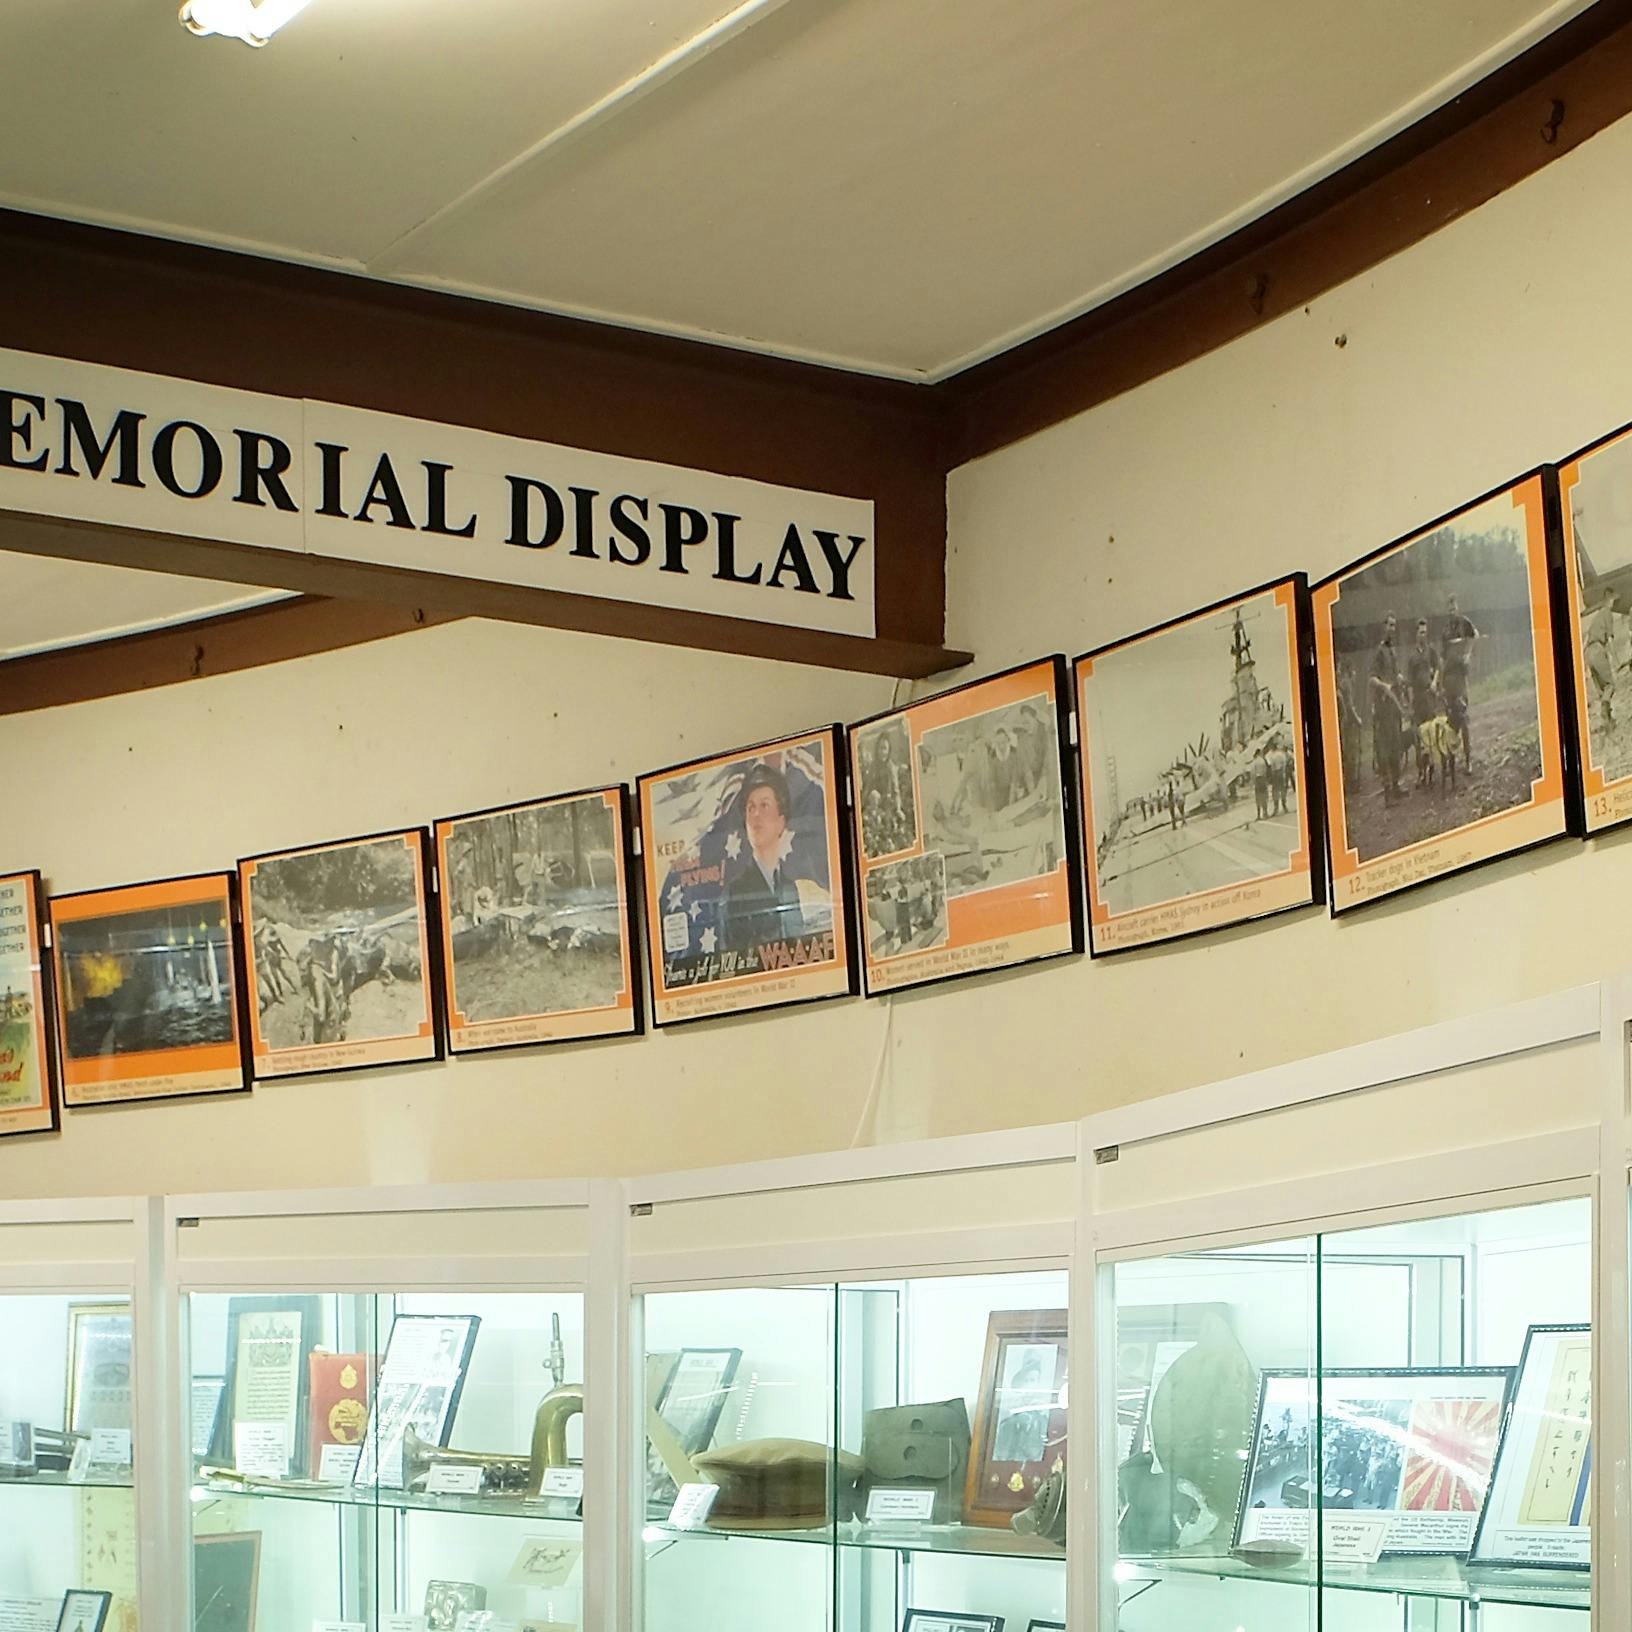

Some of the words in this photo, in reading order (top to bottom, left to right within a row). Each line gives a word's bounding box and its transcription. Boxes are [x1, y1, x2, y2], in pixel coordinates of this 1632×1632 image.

[505, 473, 867, 602] DISPLAY
[1594, 798, 1612, 817] 13.
[657, 840, 685, 857] KEEP
[1349, 877, 1366, 894] 12.
[1100, 926, 1116, 942] 11.
